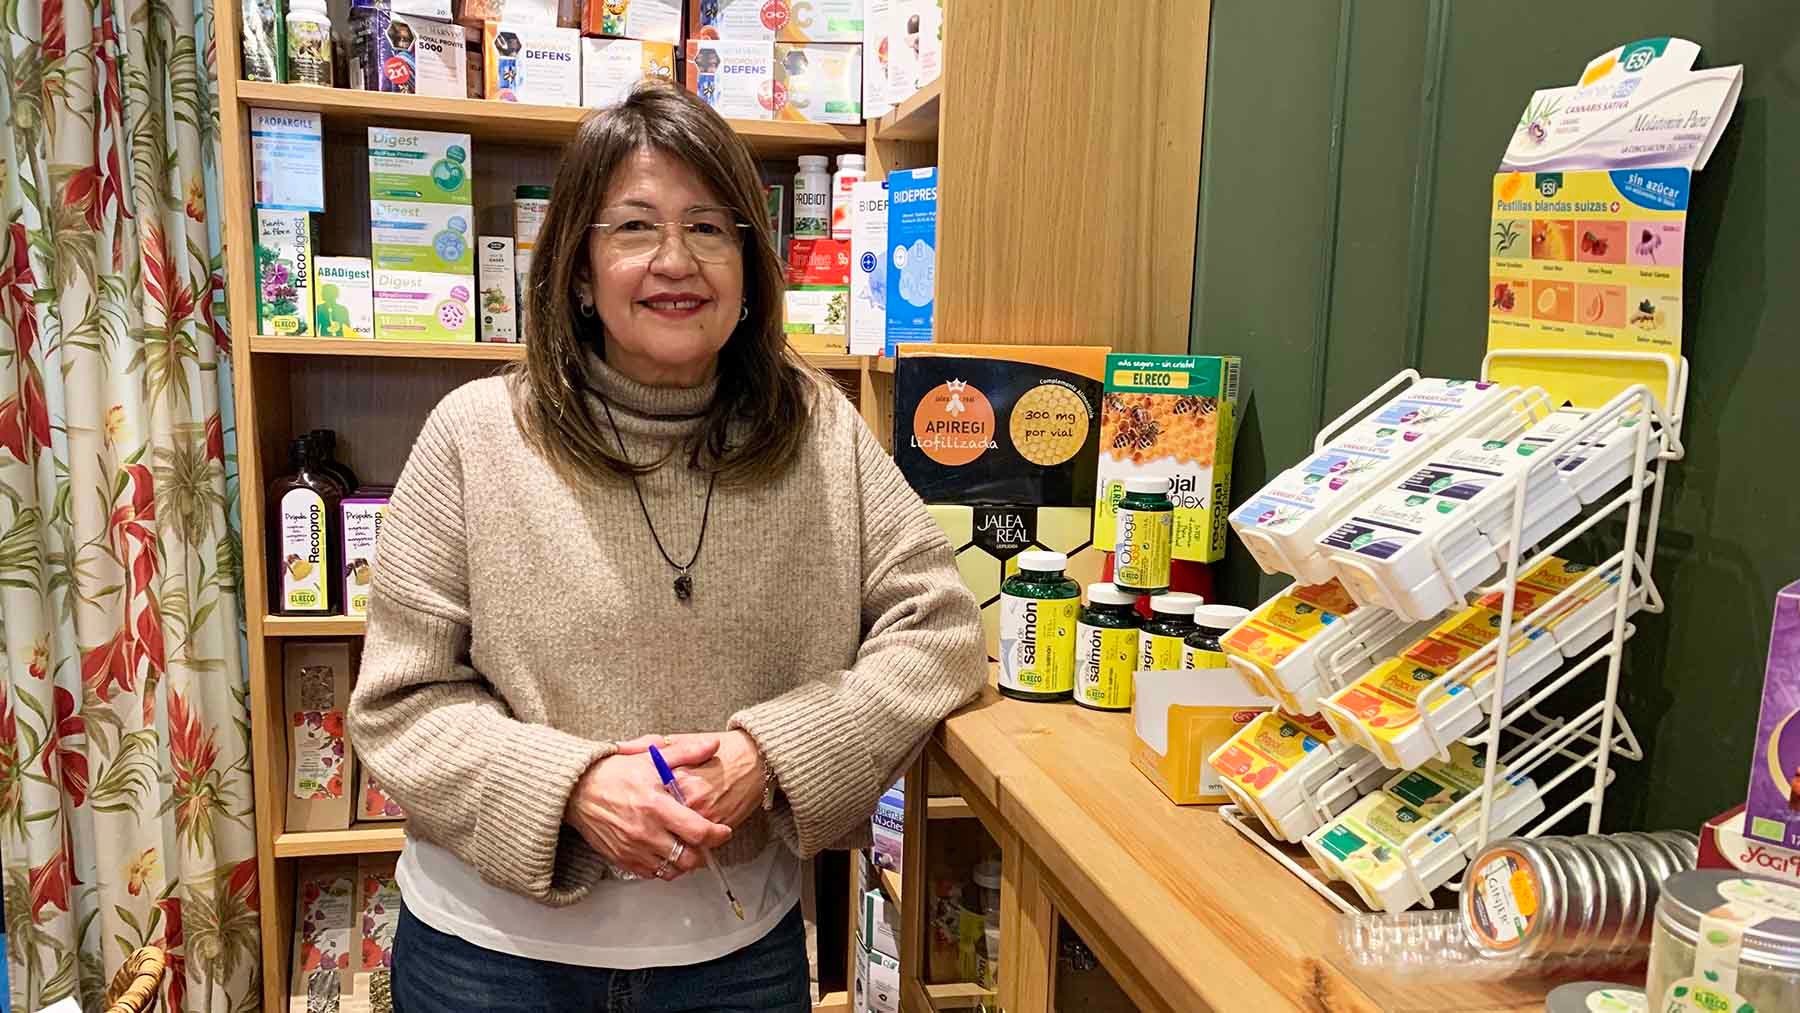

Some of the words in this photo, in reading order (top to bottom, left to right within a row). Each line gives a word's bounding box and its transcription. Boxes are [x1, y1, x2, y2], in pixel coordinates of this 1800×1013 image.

[419, 42, 443, 53] 5000
[526, 49, 572, 62] DEFENS
[1626, 50, 1651, 70] ESI
[388, 64, 409, 80] 2x1
[723, 65, 767, 74] DEFENS
[1603, 99, 1630, 110] SATIVA
[373, 132, 419, 148] Digest
[1542, 182, 1556, 196] ESI
[1628, 172, 1643, 186] sin
[1646, 177, 1680, 199] azúcar
[795, 193, 827, 206] PROBIOT
[1535, 200, 1572, 212] blandas
[1575, 200, 1608, 212] suizas
[295, 218, 309, 289] Recodigest
[318, 267, 370, 280] ABADigest
[378, 274, 422, 288] Digest
[1025, 410, 1050, 420] 300
[1055, 412, 1076, 425] mg
[925, 421, 985, 434] APIREGI
[1025, 430, 1045, 442] por
[1051, 428, 1073, 438] vial
[977, 515, 1024, 531] JALEA
[1212, 483, 1223, 552] recojal
[309, 505, 321, 563] Recoprop
[997, 529, 1031, 543] REAL
[1121, 514, 1136, 565] Omega
[1024, 601, 1038, 665] salmón
[1090, 629, 1103, 684] salmón
[875, 815, 904, 832] Noches
[1740, 845, 1788, 873] YOGI
